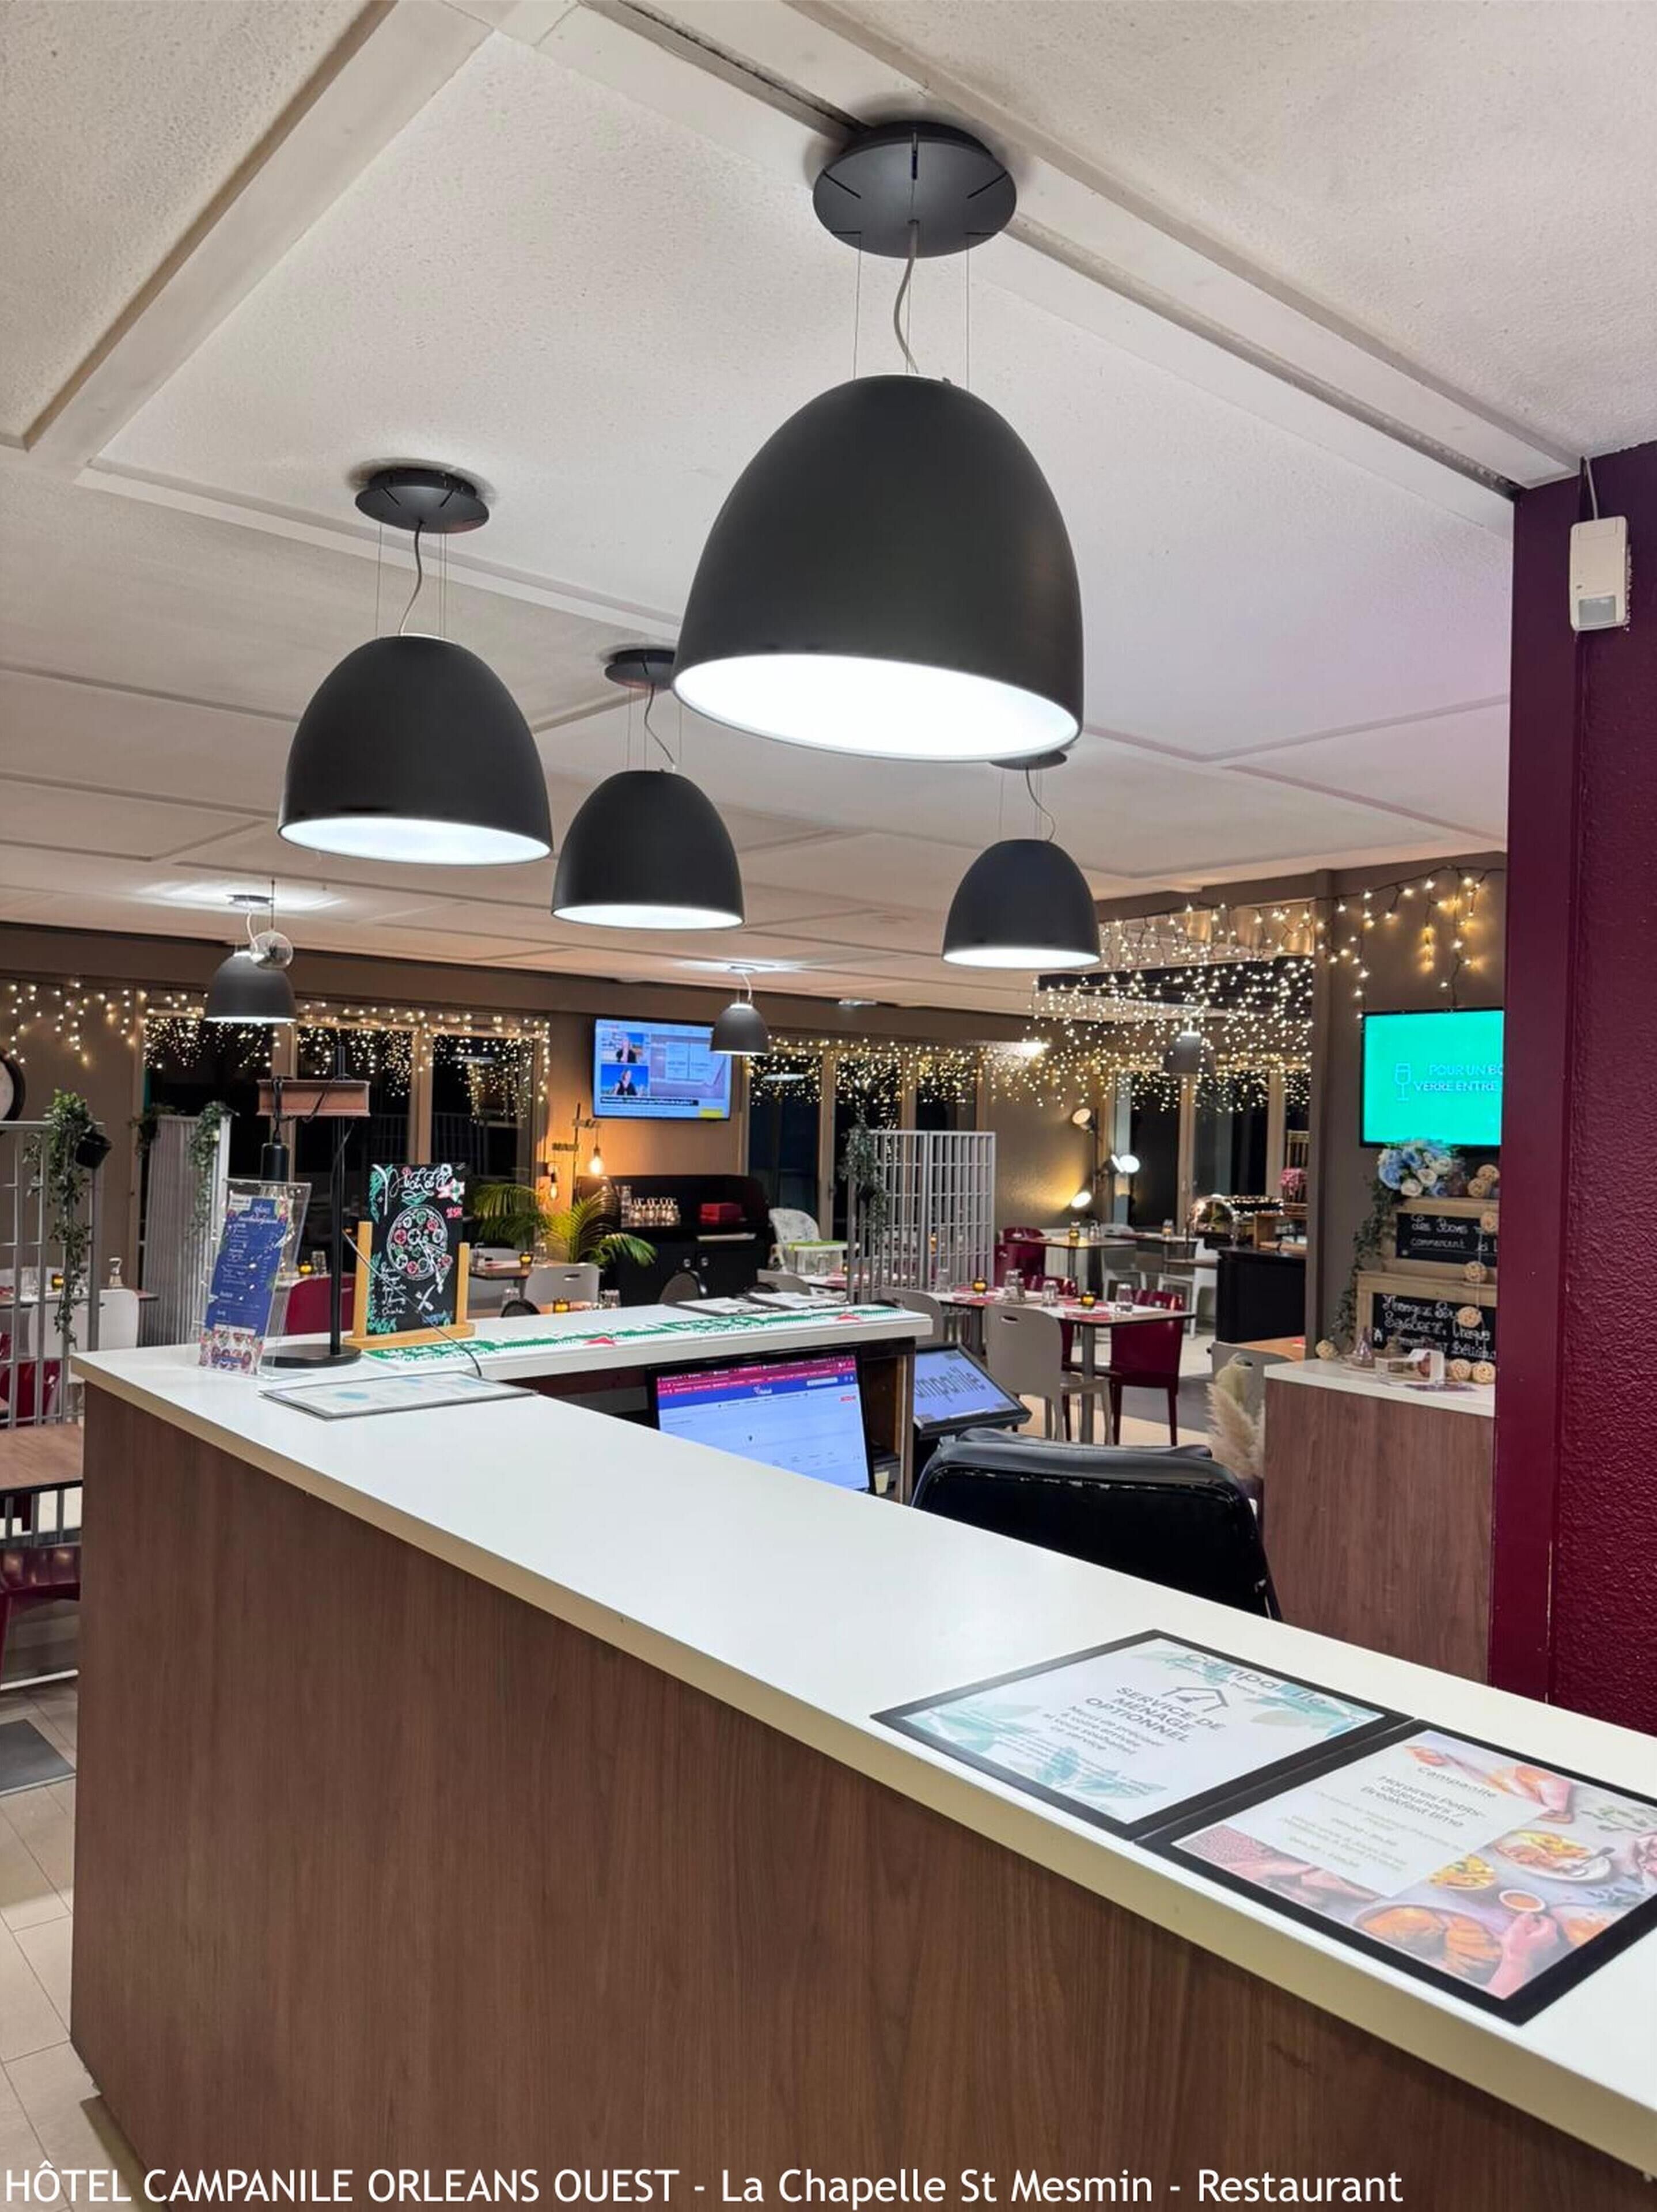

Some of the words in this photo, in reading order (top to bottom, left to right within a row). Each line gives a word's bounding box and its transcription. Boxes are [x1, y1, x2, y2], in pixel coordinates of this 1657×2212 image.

[1413, 1081, 1454, 1091] VERRE
[1456, 1080, 1498, 1091] ENTRE
[1430, 1064, 1463, 1075] POUR
[915, 1367, 987, 1403] ampanile
[1082, 1697, 1193, 1741] OPTIONNEL
[1114, 1687, 1196, 1718] SERVICE
[1195, 1718, 1226, 1730] DE
